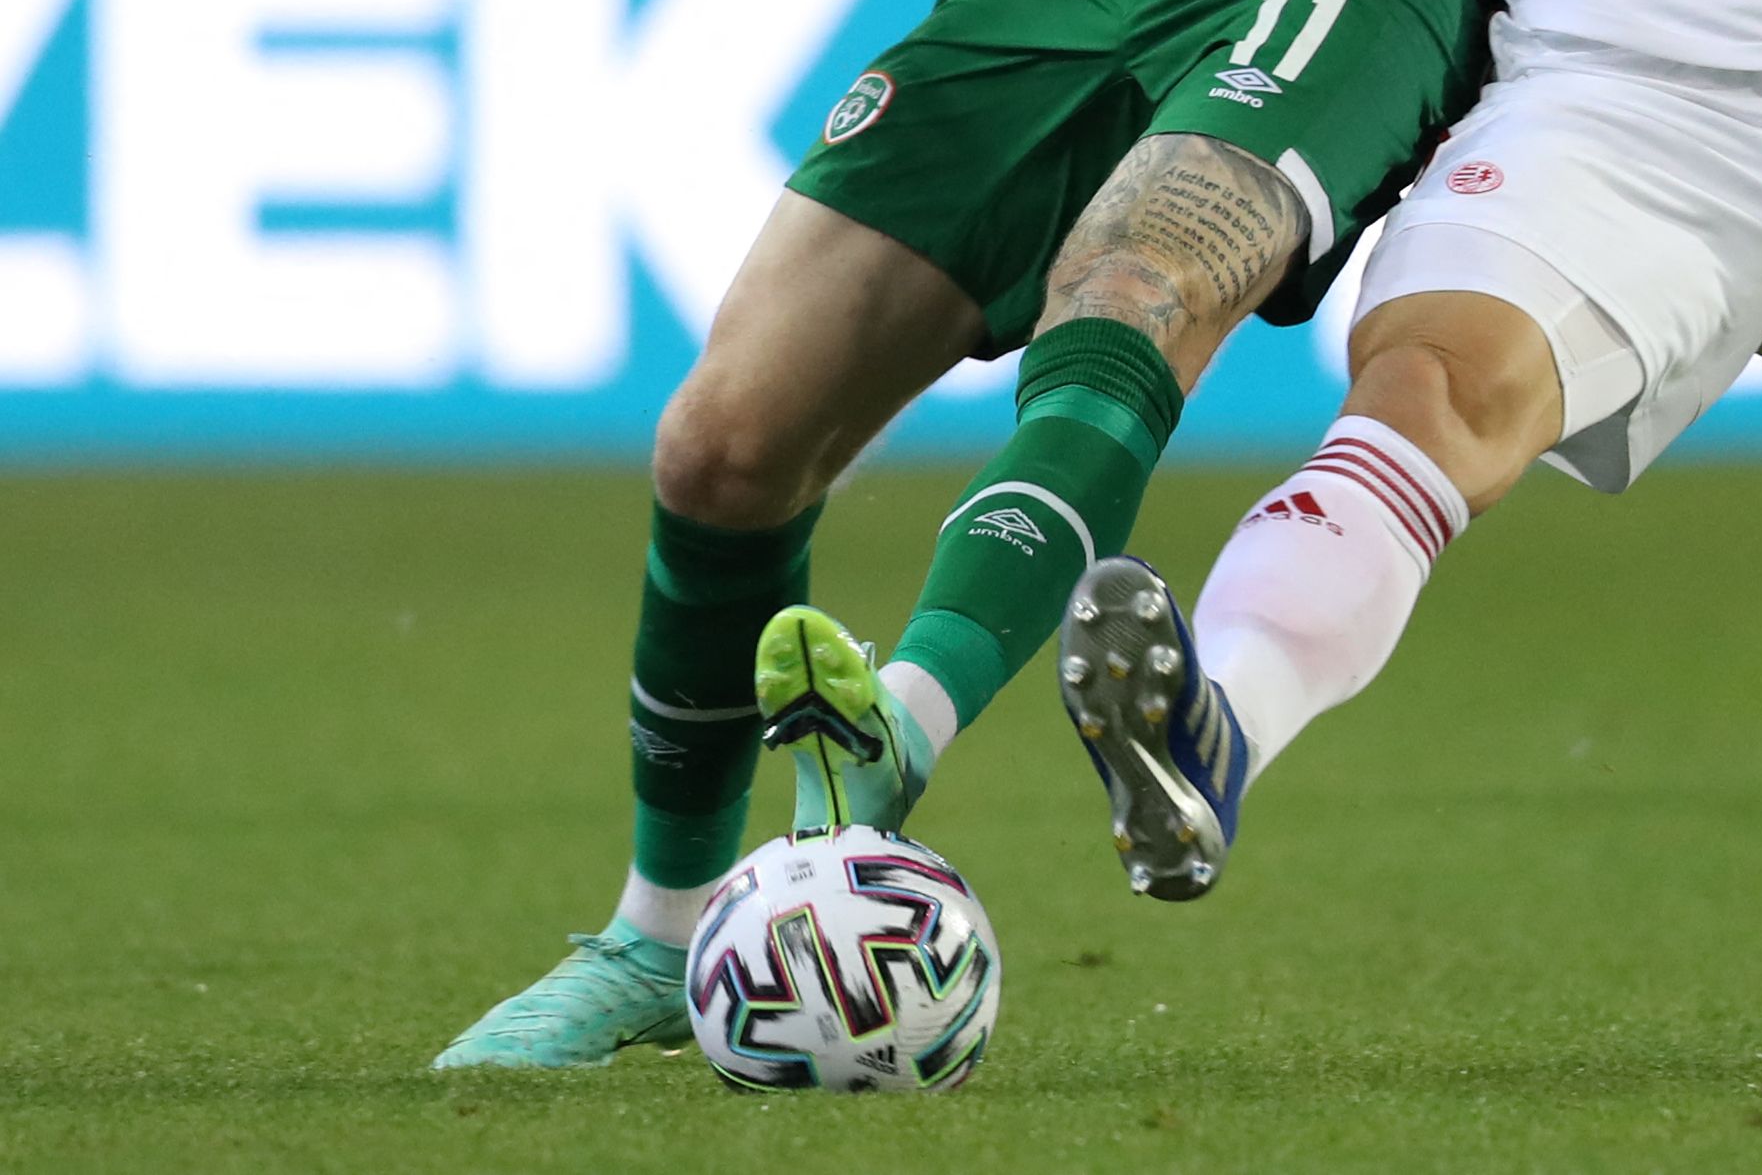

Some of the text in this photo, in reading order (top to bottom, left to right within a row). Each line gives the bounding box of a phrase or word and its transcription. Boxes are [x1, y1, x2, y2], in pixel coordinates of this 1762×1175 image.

[1208, 87, 1264, 108] umbro
[1210, 201, 1232, 220] his
[1231, 216, 1257, 247] baby
[1221, 187, 1234, 201] is
[1235, 198, 1275, 239] always
[1183, 226, 1204, 244] she
[968, 528, 1034, 557] umbro
